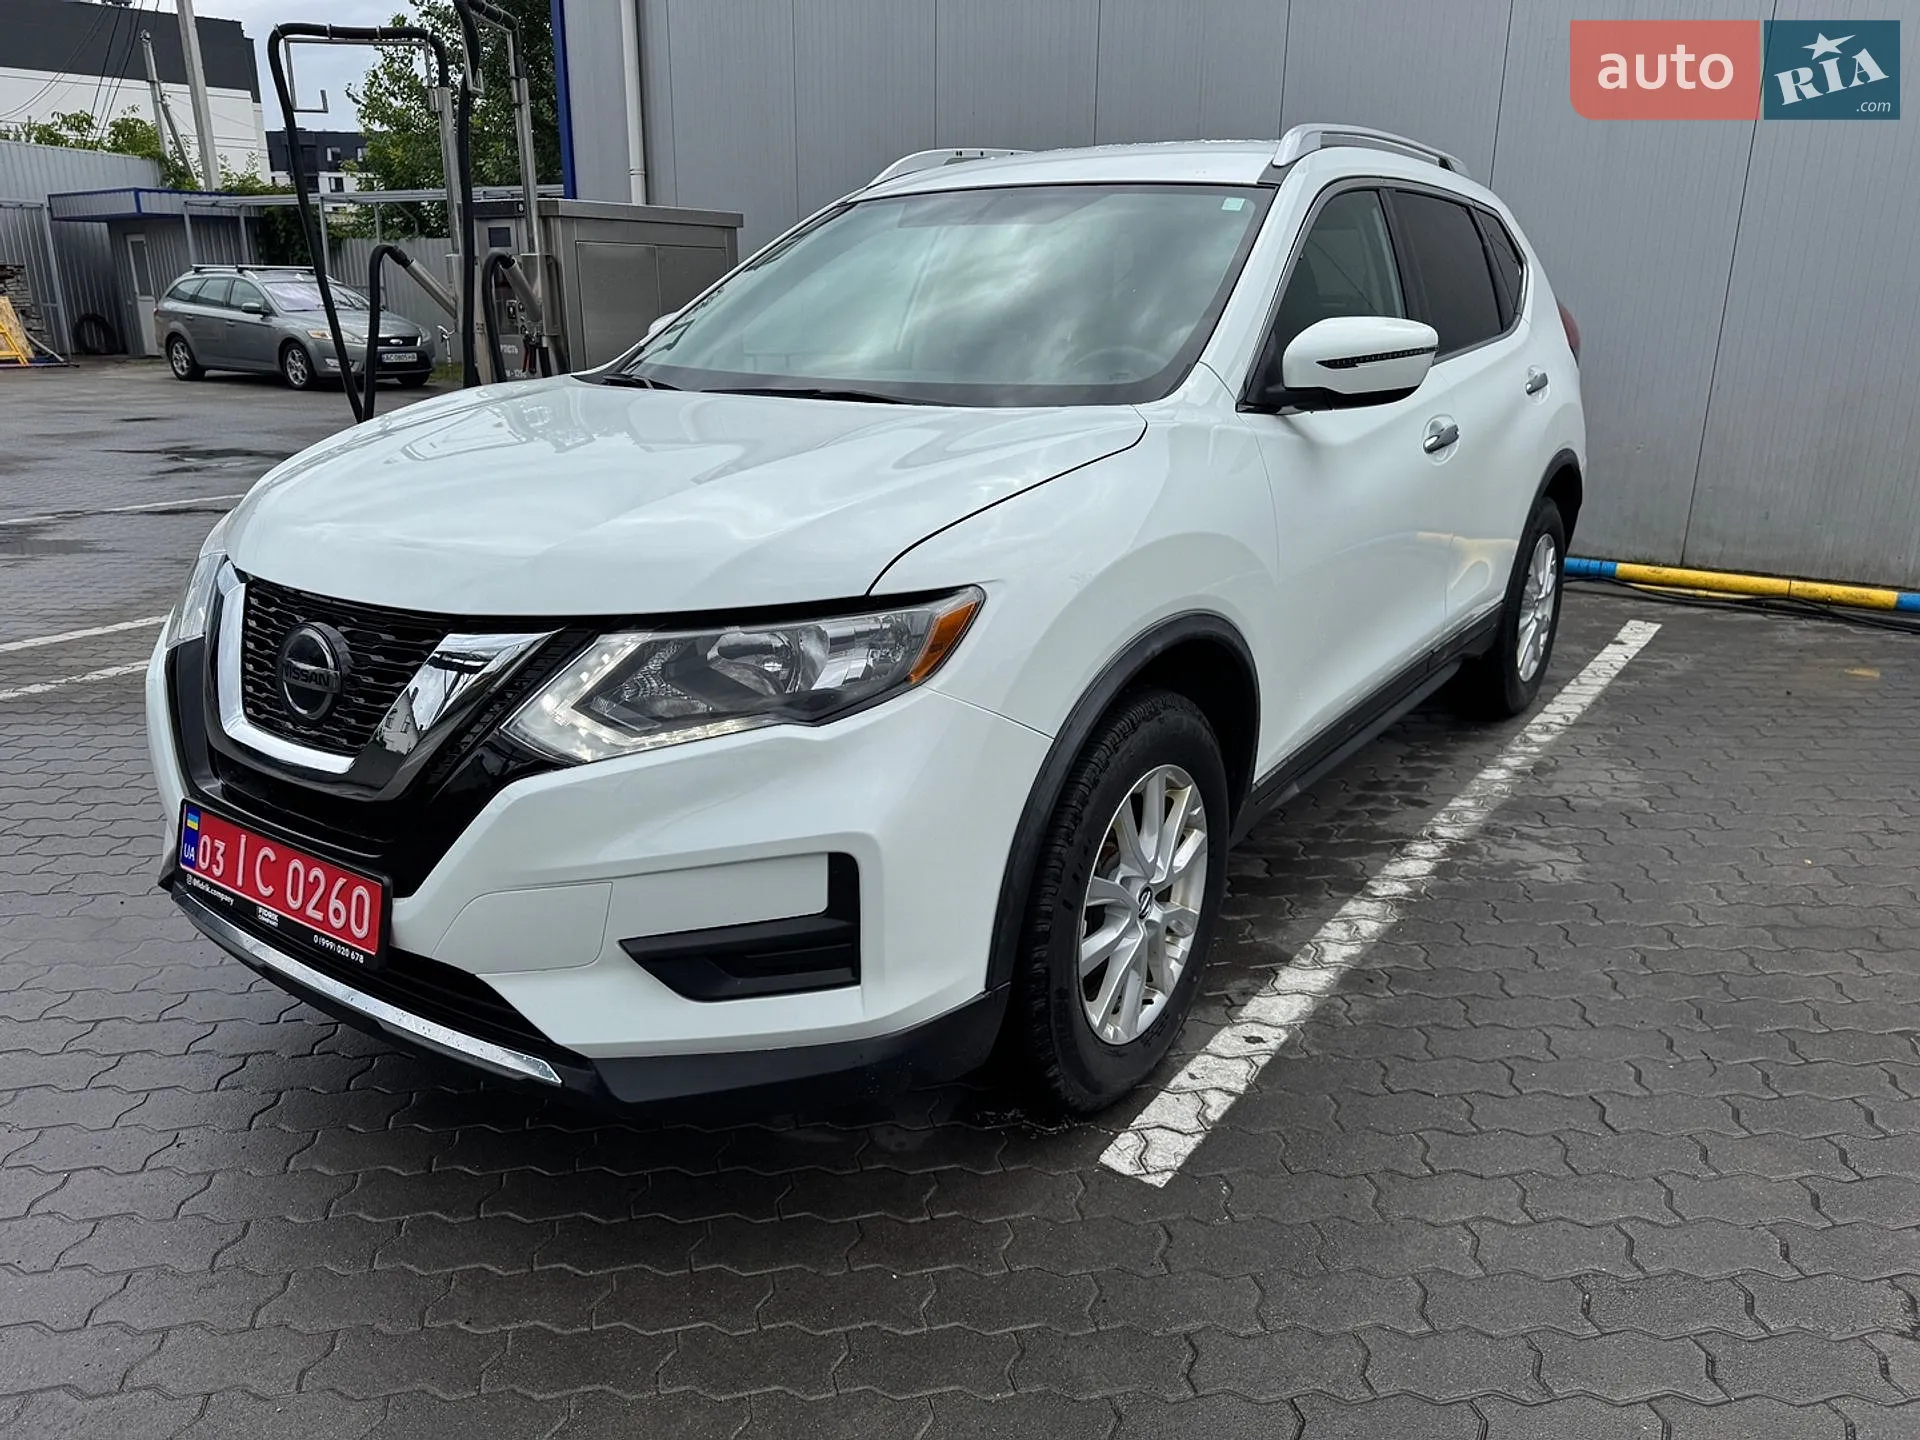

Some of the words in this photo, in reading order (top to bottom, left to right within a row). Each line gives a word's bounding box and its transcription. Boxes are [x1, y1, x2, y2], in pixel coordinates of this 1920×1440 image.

[283, 662, 330, 687] NISSAN
[183, 843, 196, 861] UA
[198, 834, 226, 877] 03
[286, 858, 371, 939] 0260
